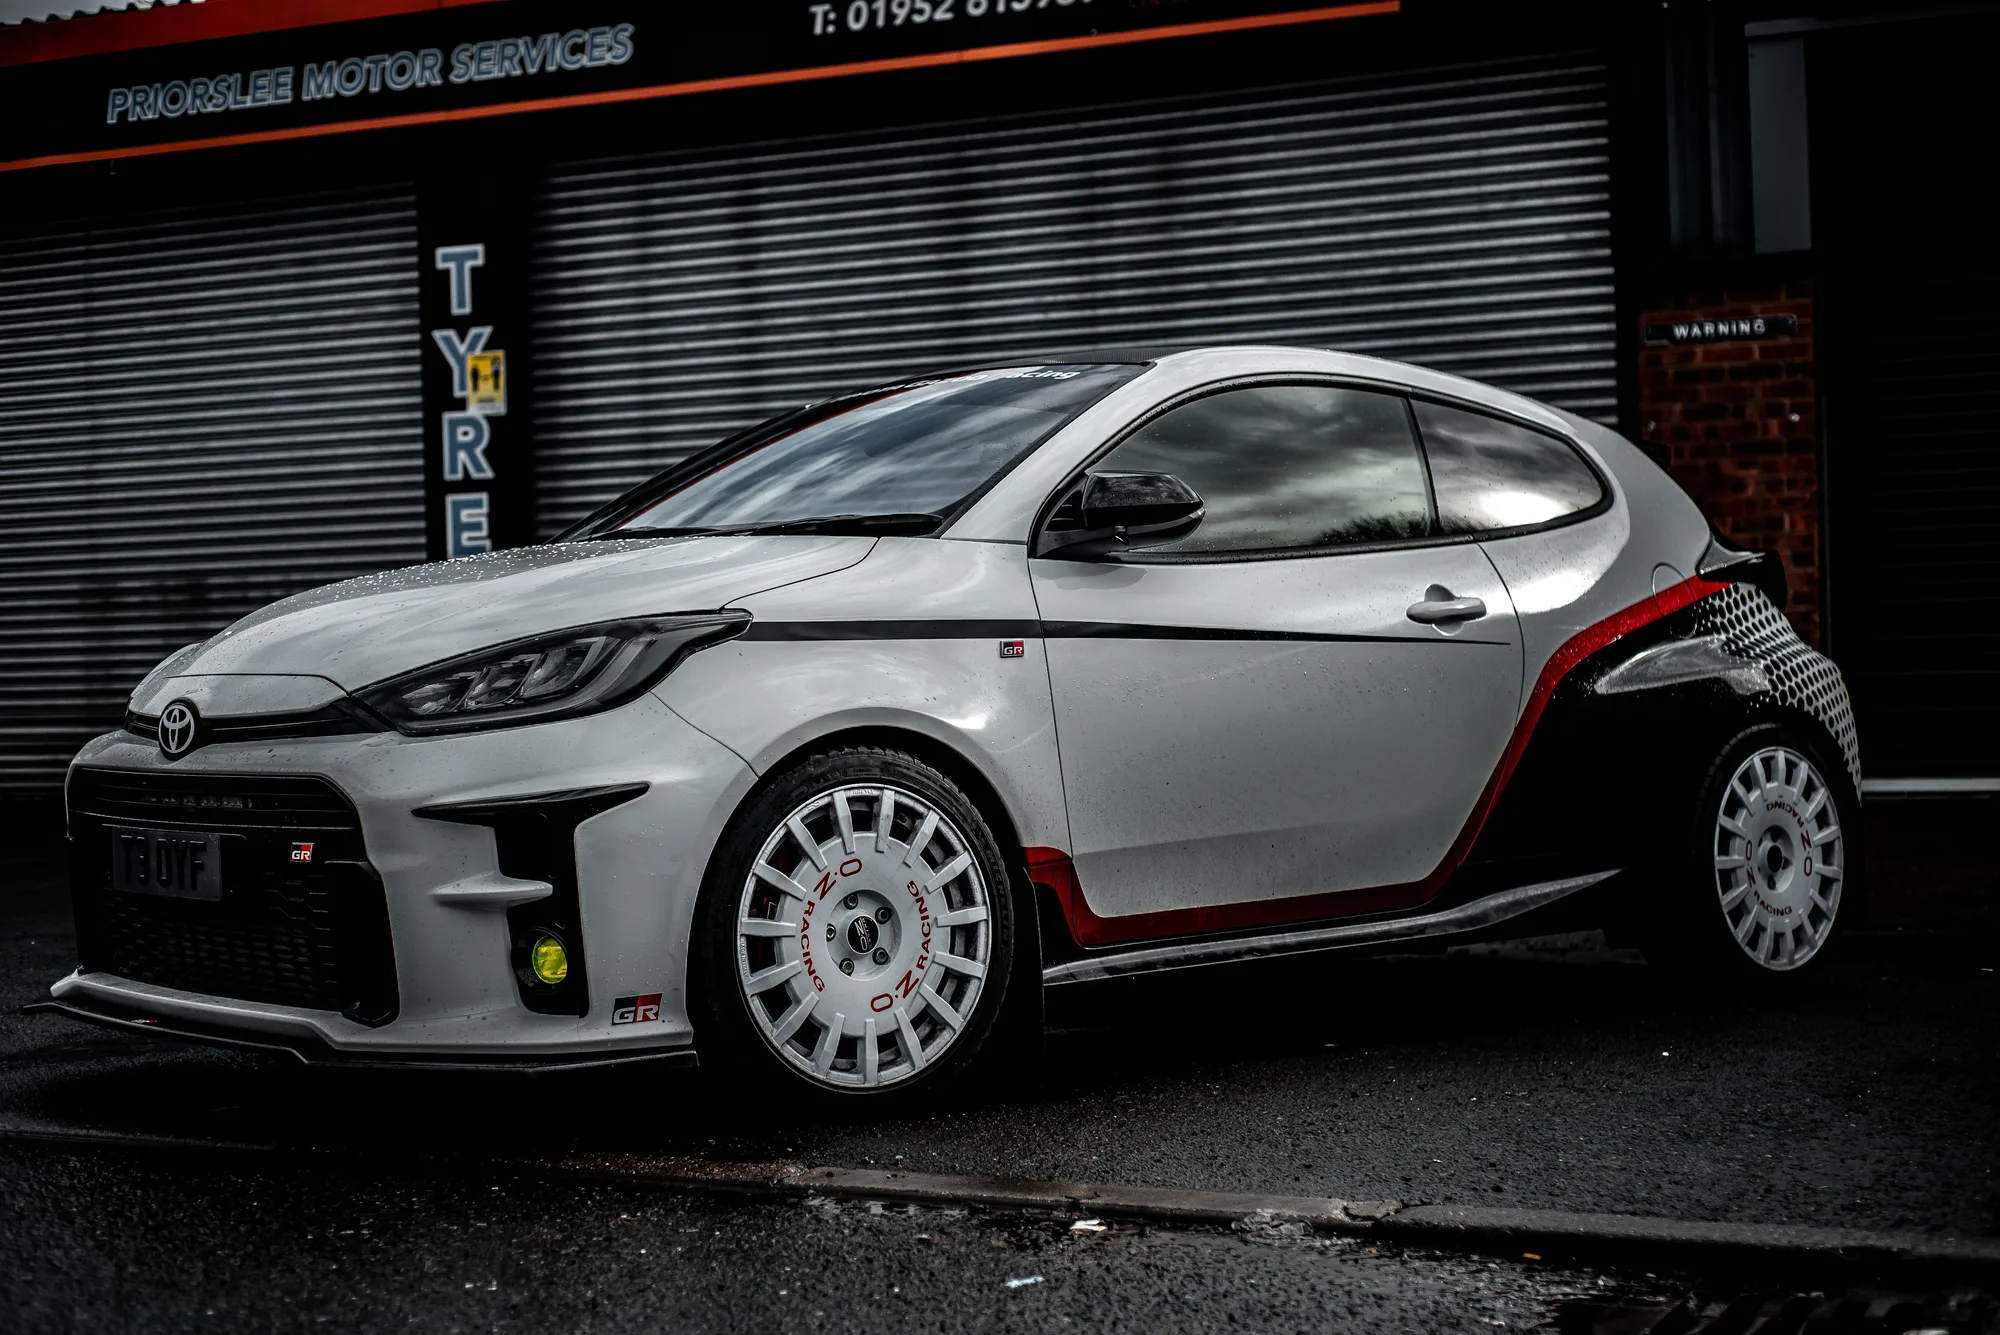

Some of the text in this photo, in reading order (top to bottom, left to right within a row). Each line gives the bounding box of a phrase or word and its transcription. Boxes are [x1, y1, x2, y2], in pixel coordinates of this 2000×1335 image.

[808, 3, 838, 36] T:
[846, 0, 955, 32] 01952
[107, 23, 635, 124] PRIORSLEE MOTOR SERVICES
[1672, 318, 1766, 340] WARNING
[430, 243, 496, 559] TYRE
[1766, 801, 1805, 828] RACING
[800, 900, 826, 992] RACING
[906, 880, 932, 971] RACING
[613, 1004, 659, 1024] GR
